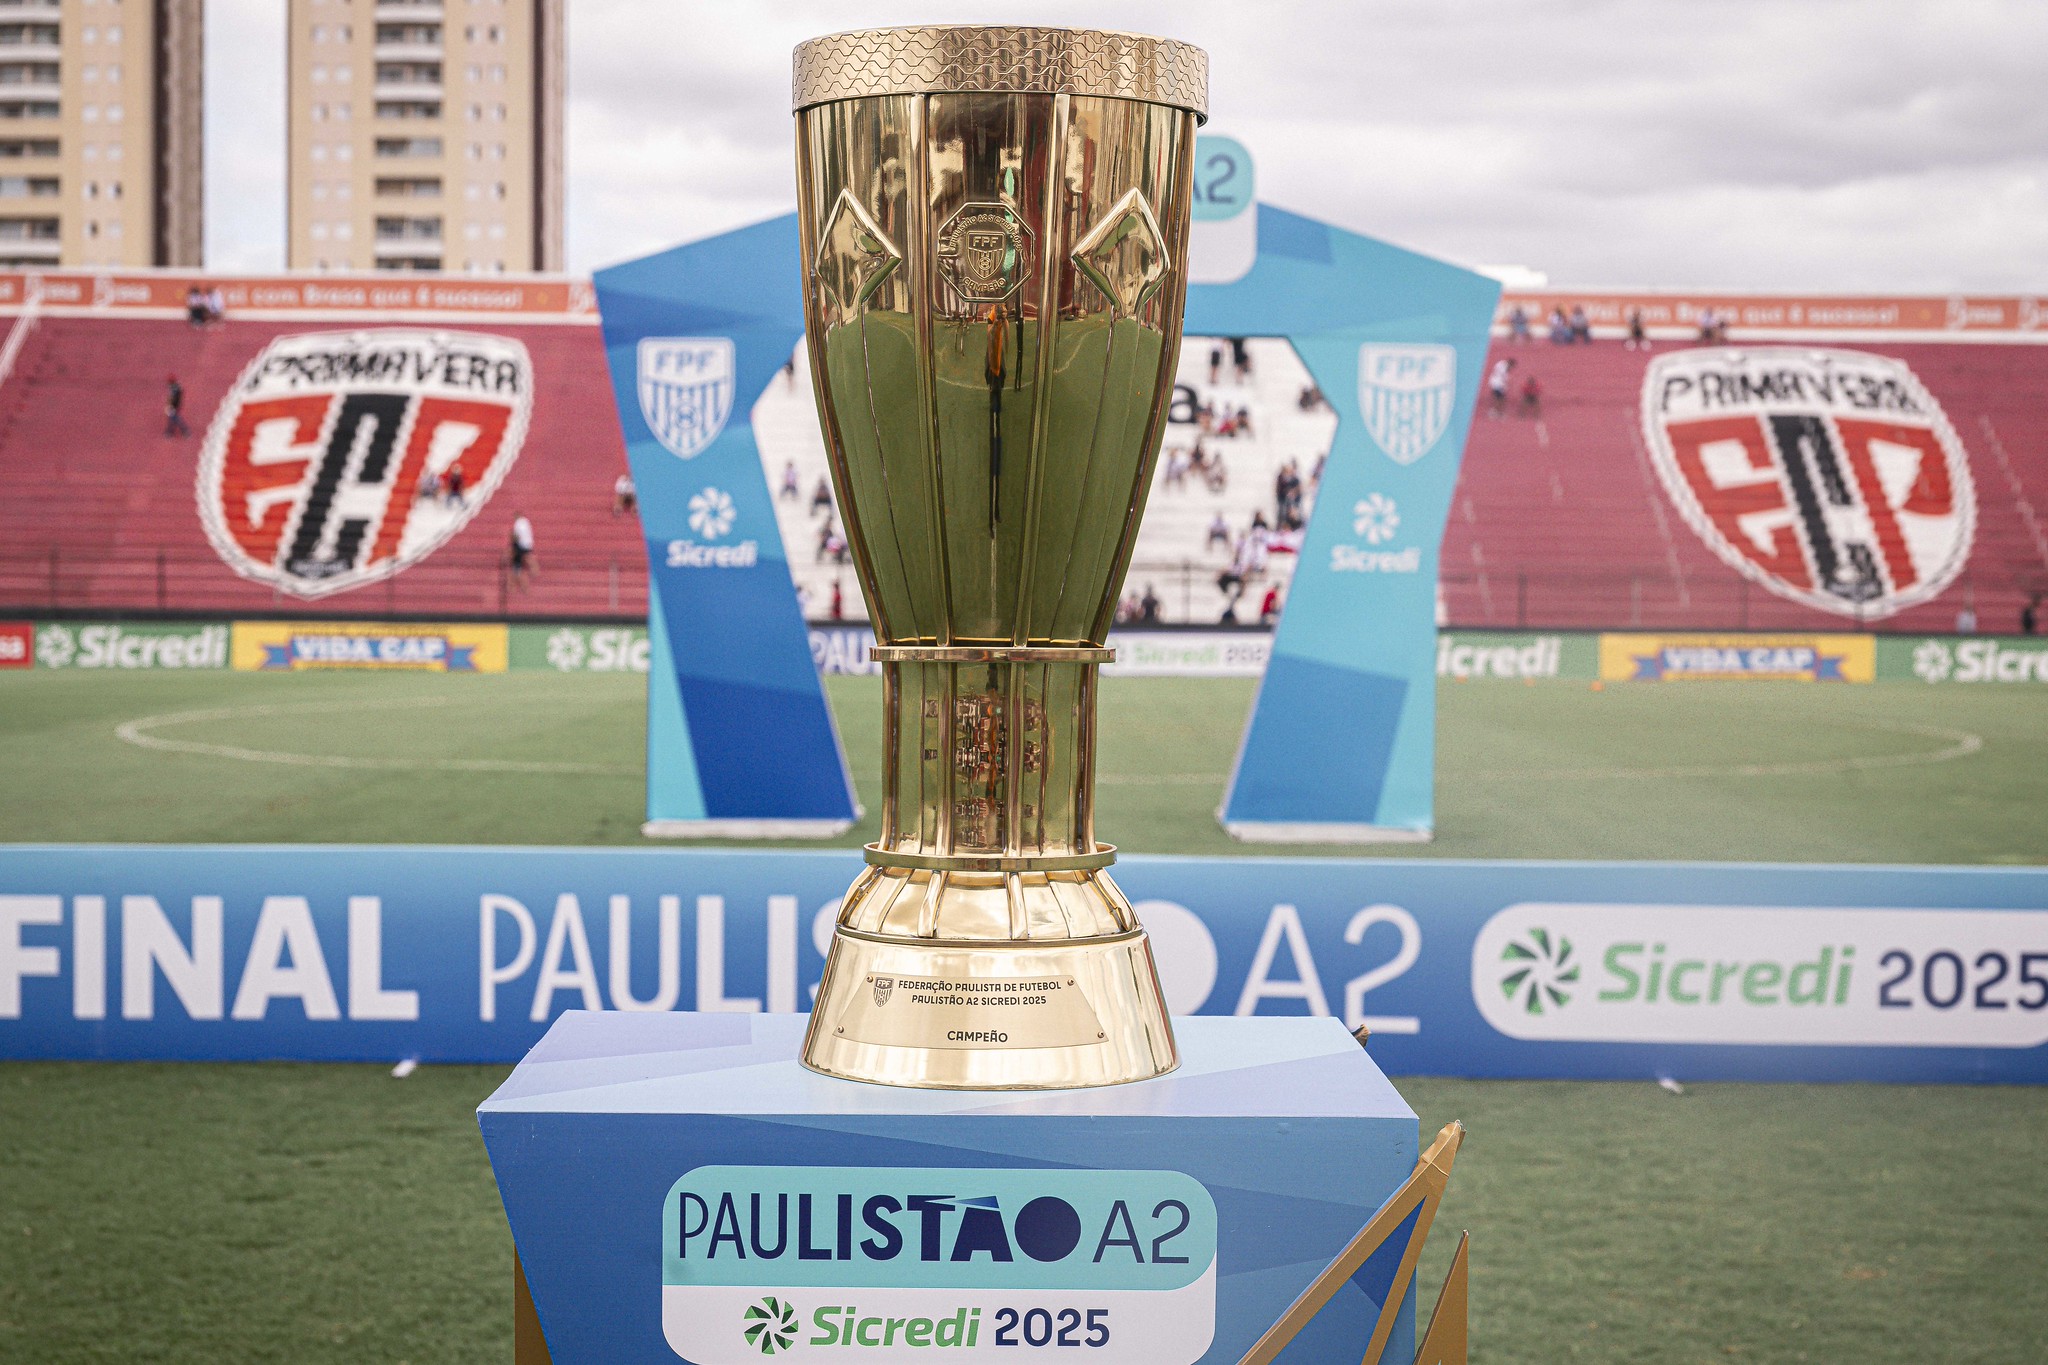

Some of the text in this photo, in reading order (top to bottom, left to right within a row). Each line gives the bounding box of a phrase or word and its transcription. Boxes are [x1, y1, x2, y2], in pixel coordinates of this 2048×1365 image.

[1194, 152, 1236, 204] 2
[973, 236, 999, 247] FPF
[250, 351, 518, 393] PRIMAVERA
[655, 350, 715, 374] FPF
[1377, 355, 1437, 380] FPF
[1661, 368, 1927, 415] PRIMAVERA
[666, 540, 758, 568] Sicredi
[1329, 545, 1421, 573] Sicredi
[77, 625, 229, 668] Sicredi
[294, 635, 447, 662] VIDA CAP
[1437, 635, 1562, 678] icredi
[1663, 646, 1814, 673] VIDA CAP
[0, 894, 420, 1021] FINAL
[1238, 902, 1421, 1035] A2
[1598, 943, 1857, 1007] Sicredi
[1878, 949, 2048, 1010] 2025
[898, 980, 1062, 993] FEDERAÇÃO PAULISTA DE FUTEBOL
[911, 994, 1047, 1006] PAULISTÃO A2 SICREDI 2025
[947, 1030, 1008, 1043] CAMPEÃO
[1092, 1198, 1191, 1264] A2
[809, 1305, 1111, 1348] Sicredi 2025
